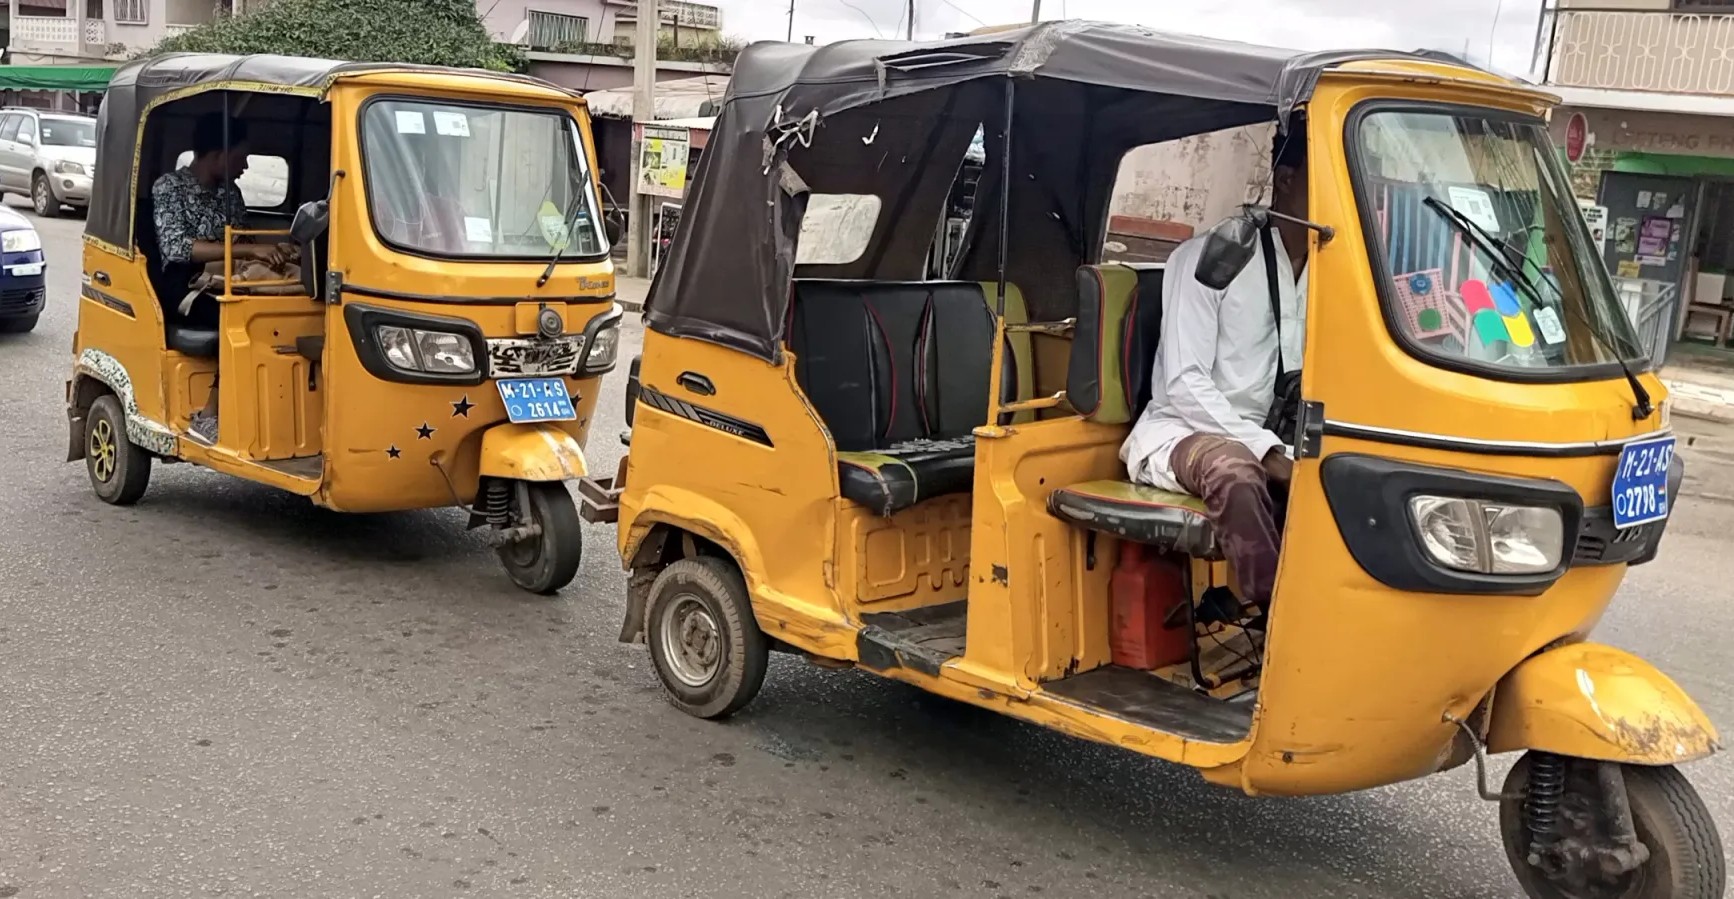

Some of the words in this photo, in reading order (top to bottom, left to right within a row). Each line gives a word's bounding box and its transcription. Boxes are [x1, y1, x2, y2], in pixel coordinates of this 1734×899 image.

[528, 402, 561, 418] 2614
[709, 420, 745, 436] DELUXE
[1622, 444, 1673, 479] M-21-AS
[1626, 484, 1656, 518] 2798
